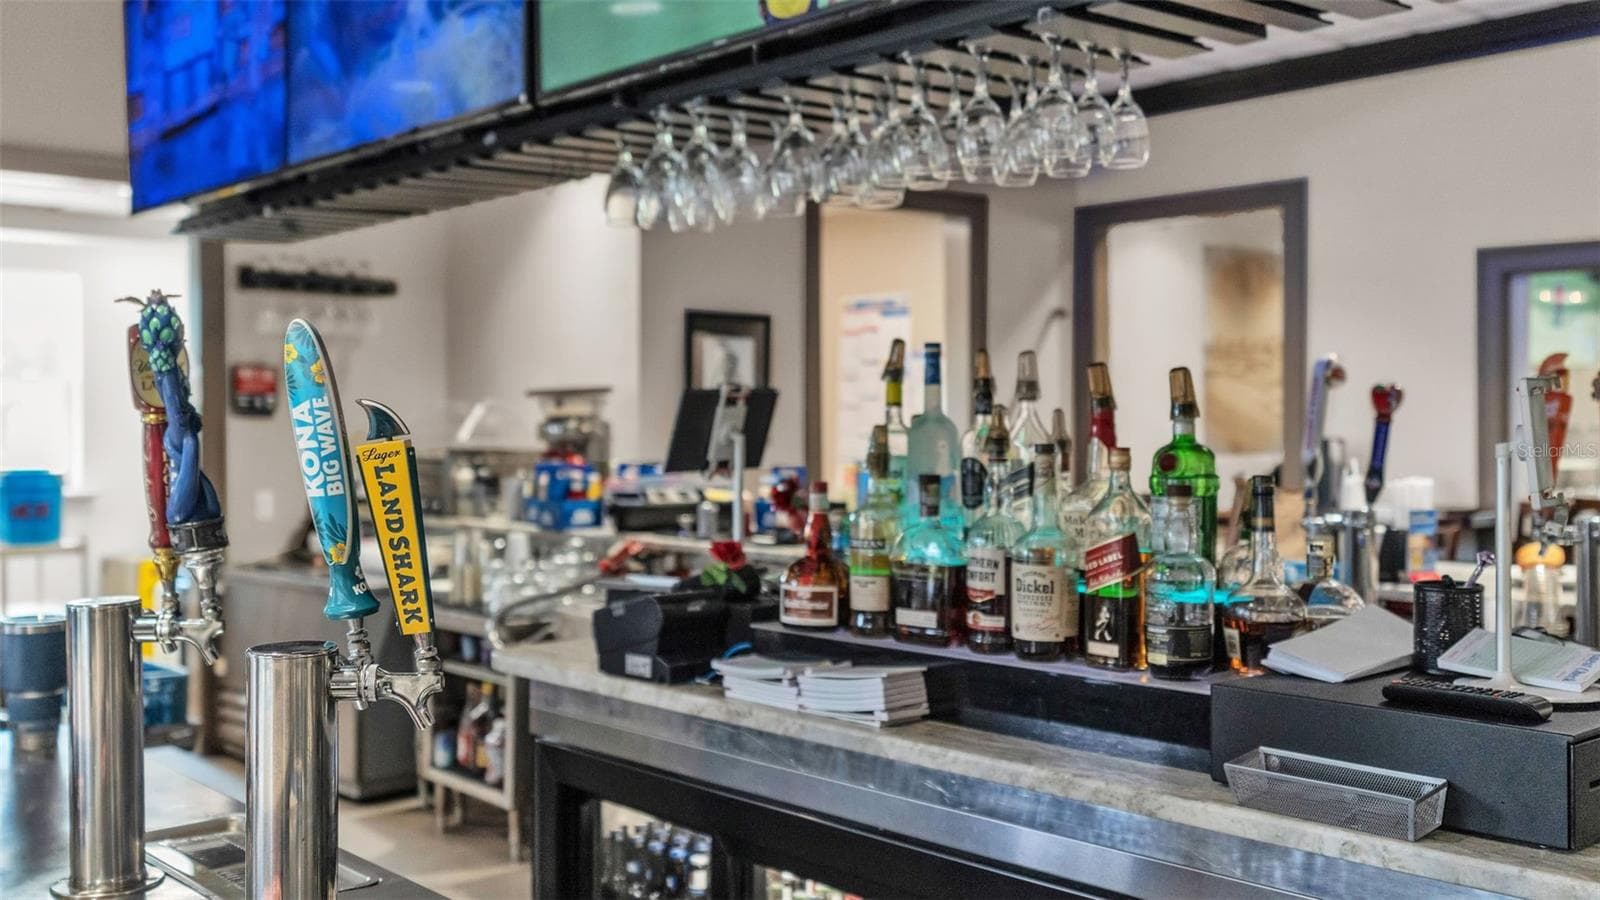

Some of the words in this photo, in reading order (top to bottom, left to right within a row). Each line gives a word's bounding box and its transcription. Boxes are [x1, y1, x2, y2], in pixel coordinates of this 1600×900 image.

[312, 396, 338, 457] WAVE
[292, 400, 325, 497] KONA
[362, 448, 401, 464] Lager
[322, 459, 345, 497] BIG
[374, 463, 424, 625] LANDSHARK
[1099, 552, 1123, 567] LABEL
[1016, 578, 1055, 595] Dickel
